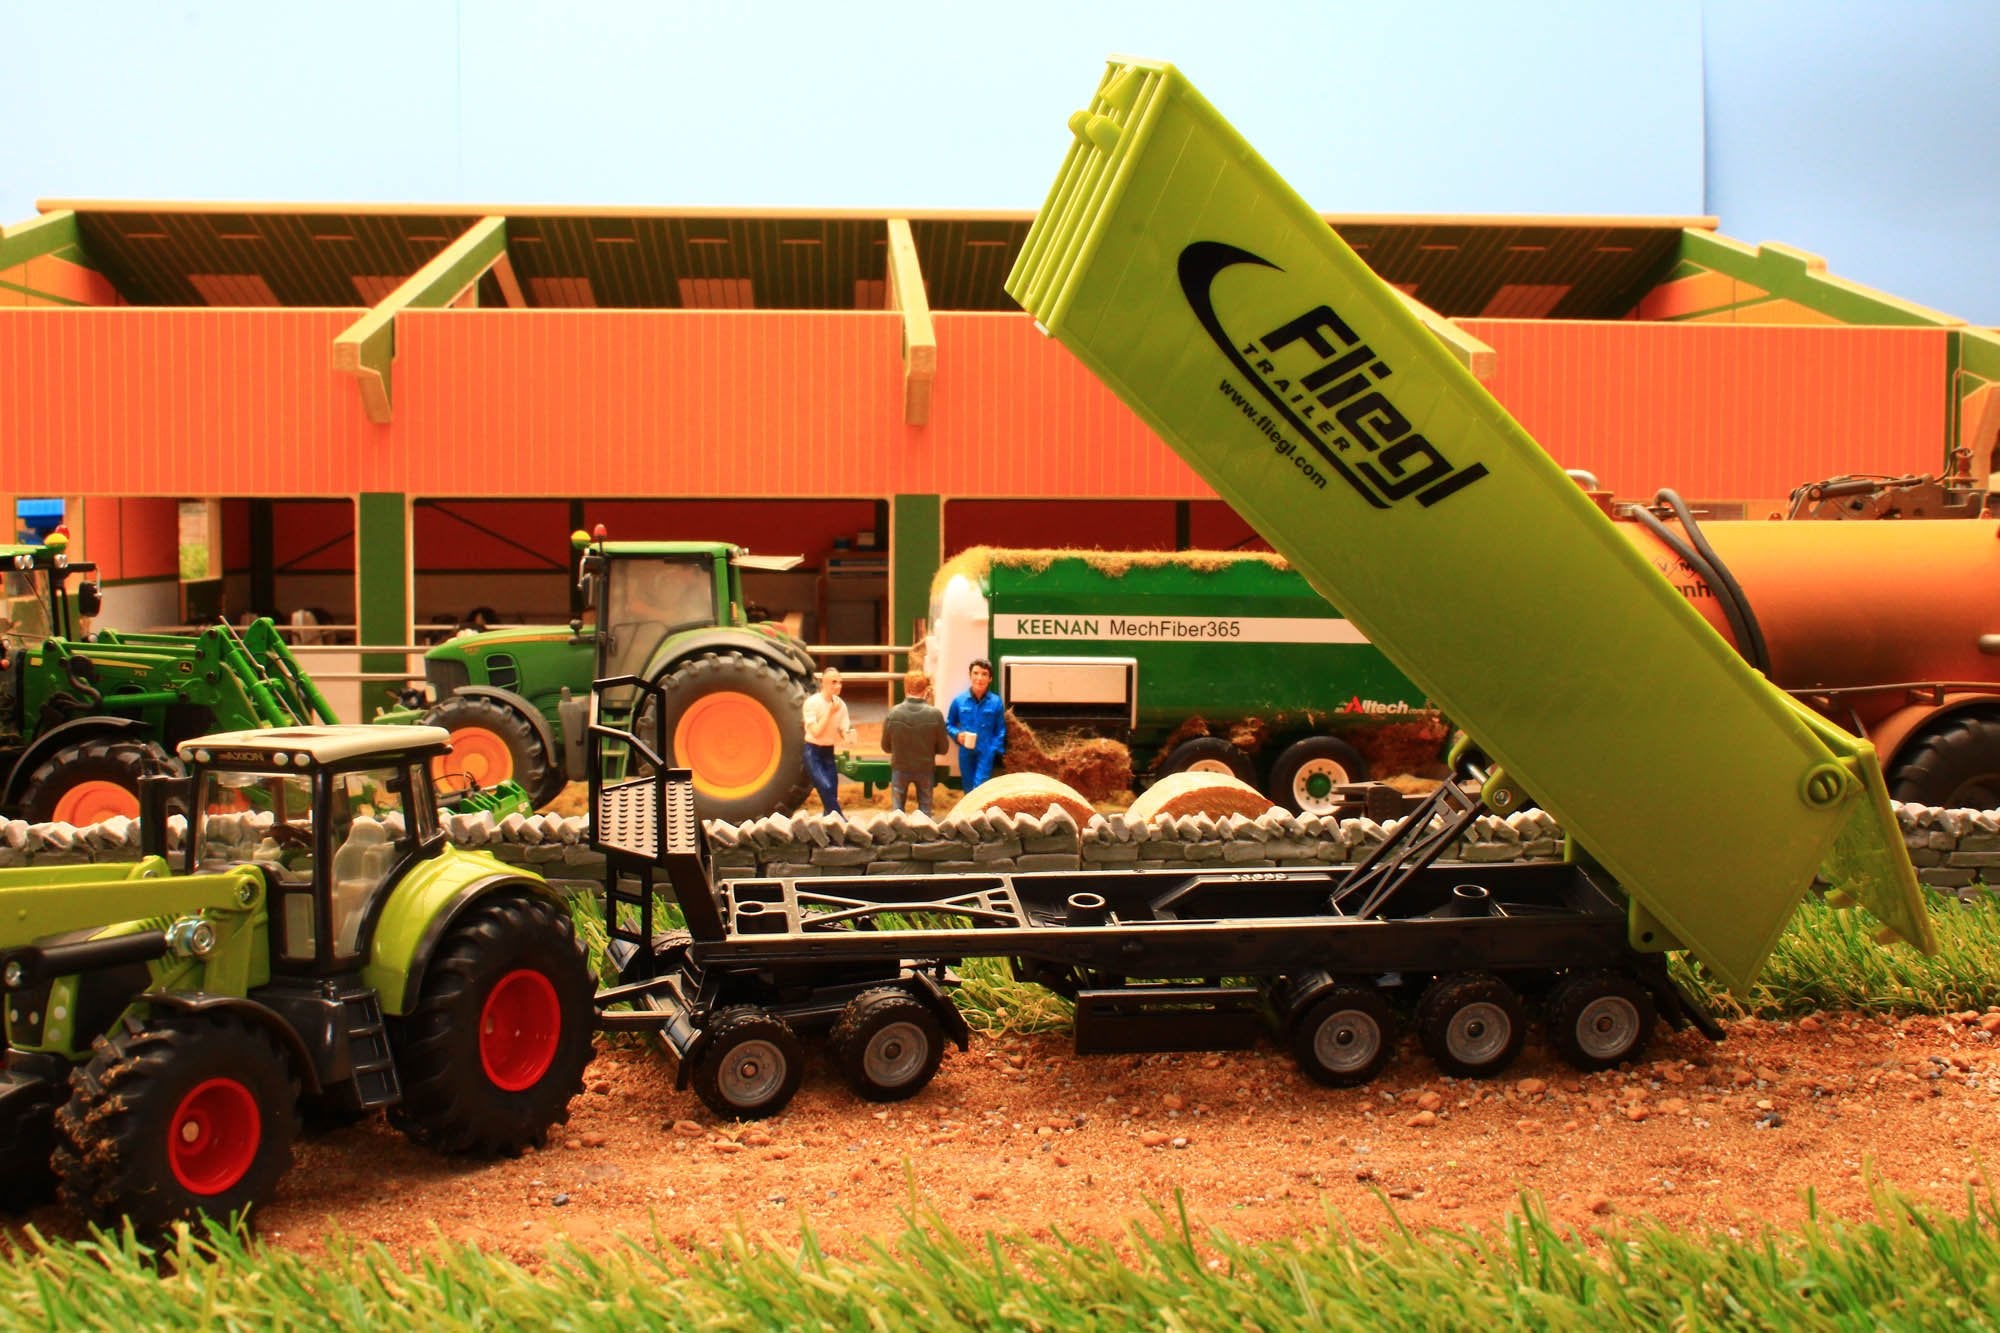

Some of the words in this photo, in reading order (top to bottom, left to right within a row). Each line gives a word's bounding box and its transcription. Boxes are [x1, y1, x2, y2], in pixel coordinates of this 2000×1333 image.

[1219, 378, 1329, 490] www.fliegl.com
[1242, 343, 1351, 452] TRAILER
[1259, 304, 1490, 508] Fliegl
[1016, 618, 1099, 635] KEENAN
[1109, 619, 1241, 637] MechFiber365
[1344, 695, 1409, 714] Alltech
